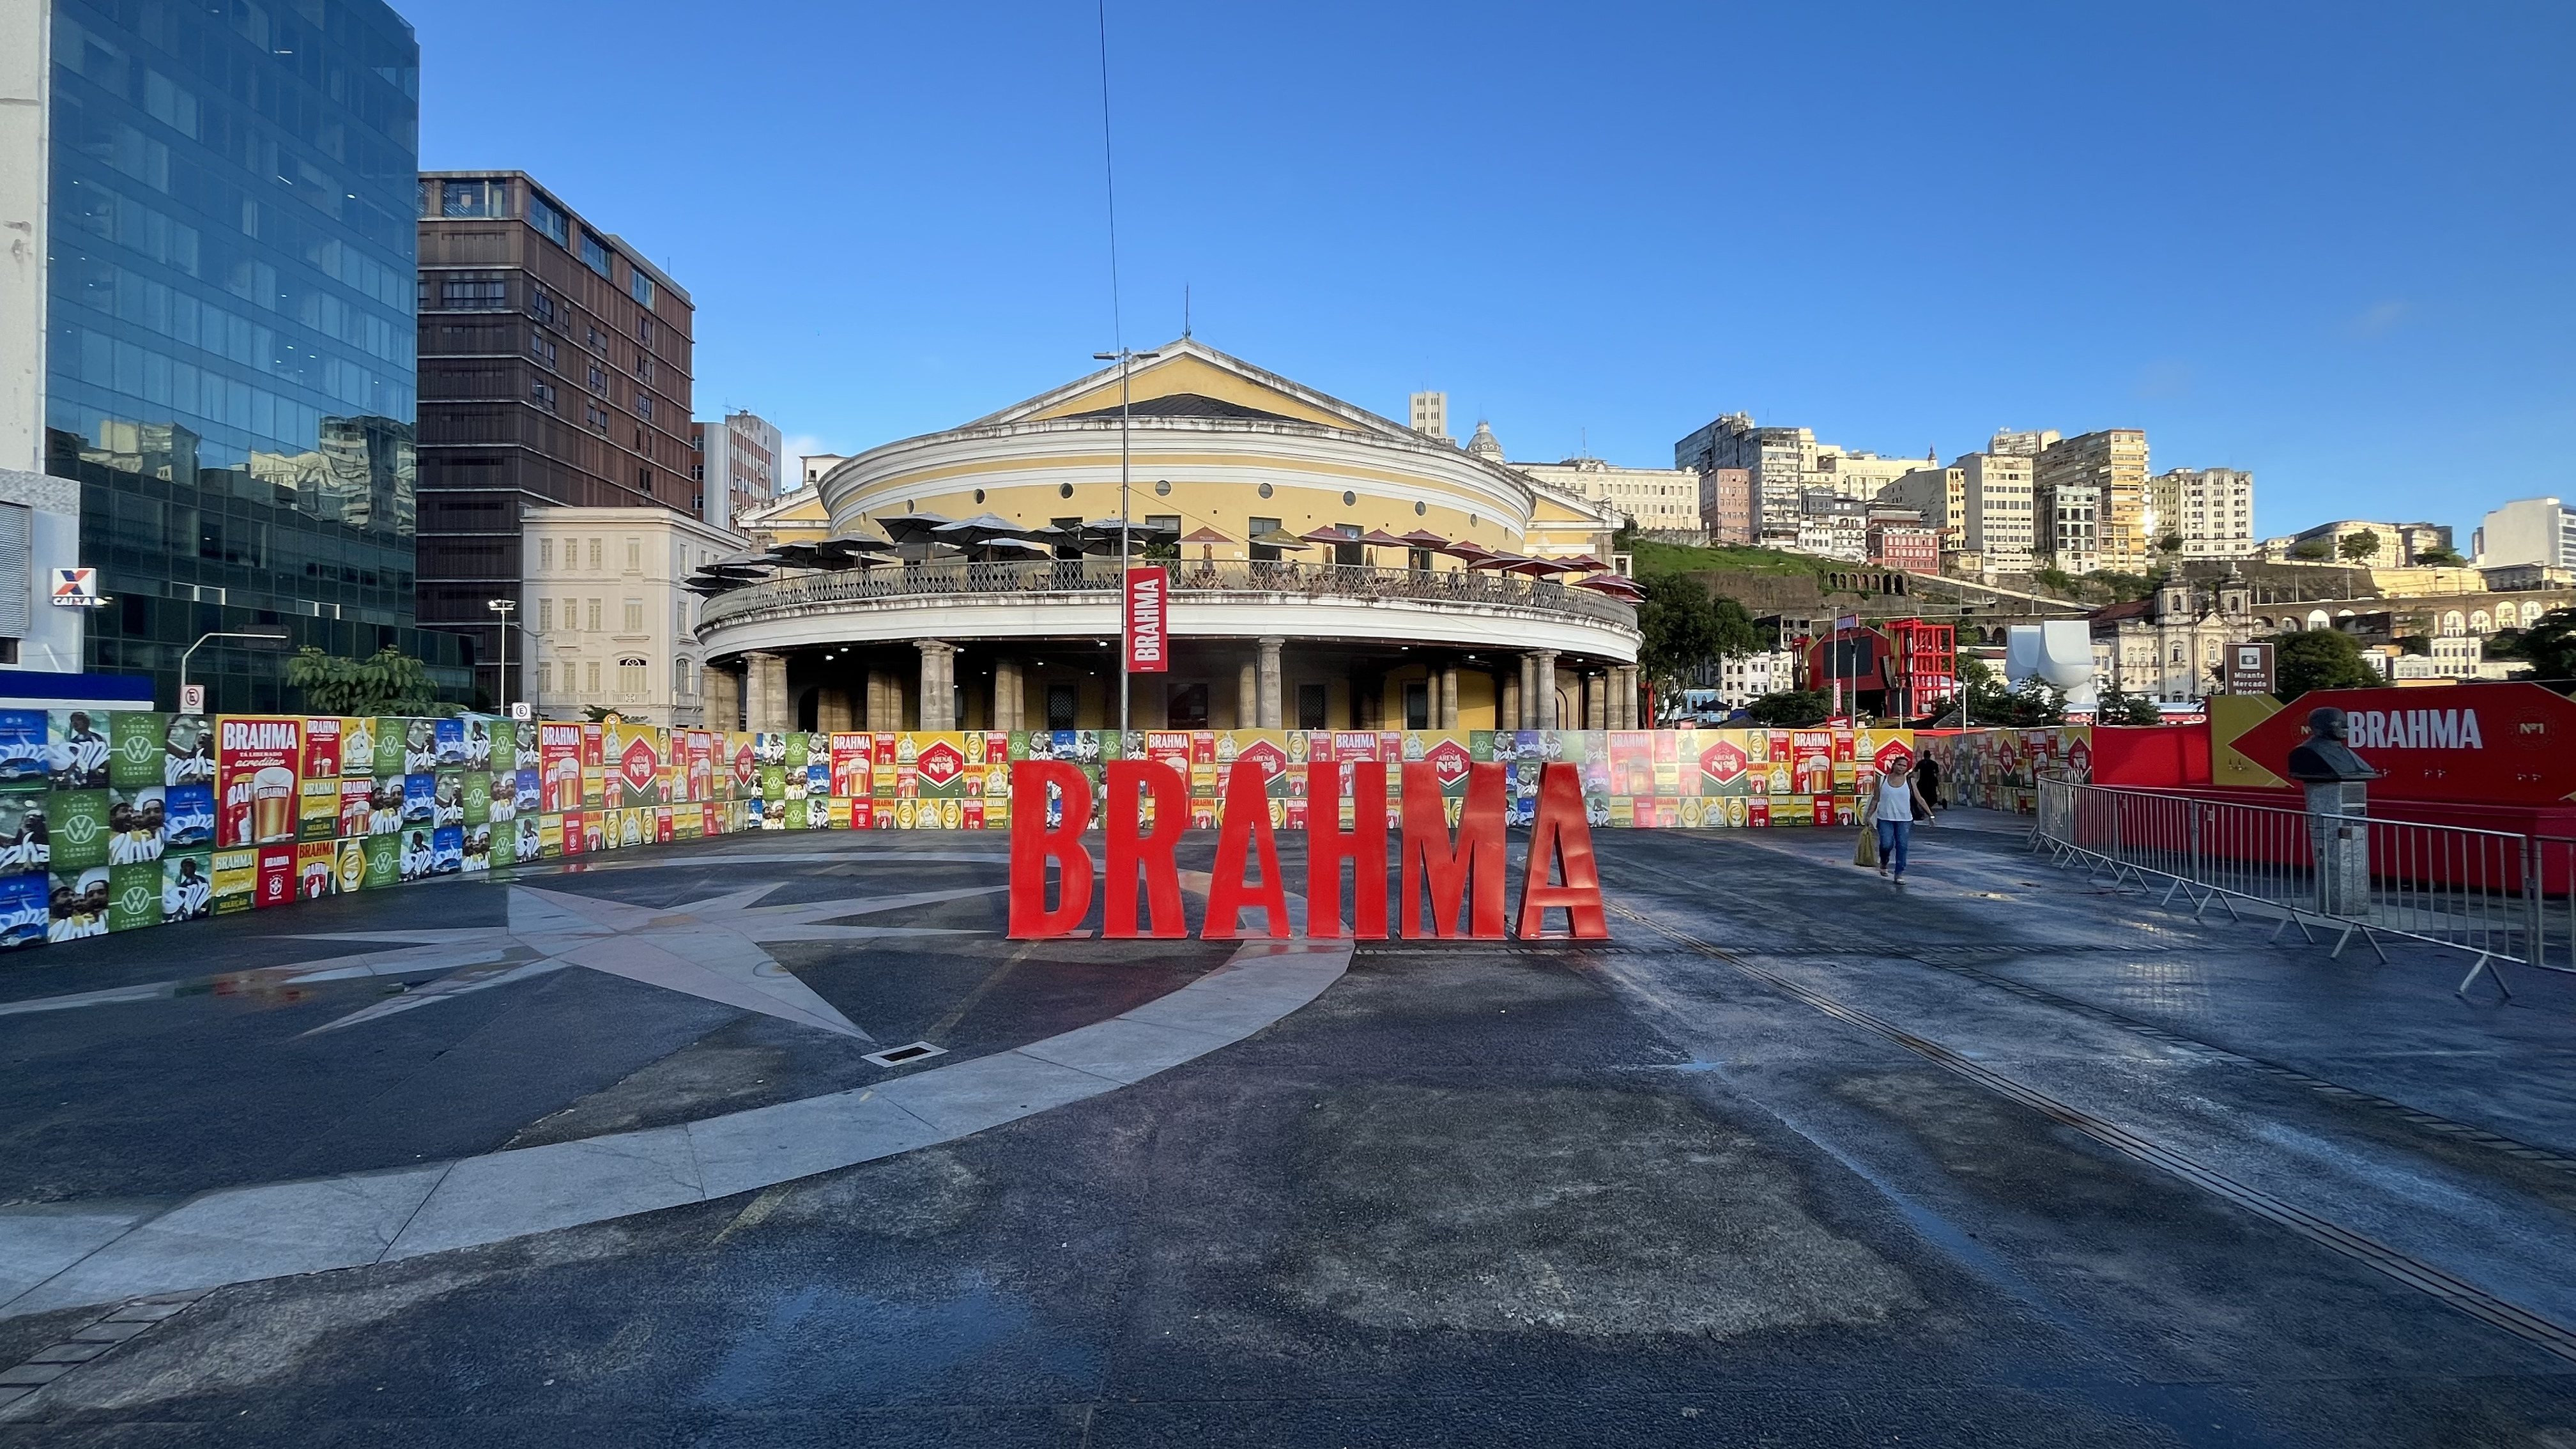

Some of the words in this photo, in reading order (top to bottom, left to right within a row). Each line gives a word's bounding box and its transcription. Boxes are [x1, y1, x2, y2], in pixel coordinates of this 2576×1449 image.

[1134, 578, 1160, 661] BRAHMA
[189, 691, 195, 702] E
[307, 721, 340, 733] BRAHMA
[2347, 709, 2483, 749] BRAHMA
[223, 723, 297, 750] BRAHMA
[542, 726, 580, 746] BRAHMA
[833, 735, 871, 750] BRAHMA
[1149, 734, 1188, 748] BRAHMA
[1336, 734, 1376, 748] BRAHMA
[1794, 733, 1831, 747] BRAHMA
[234, 757, 286, 767] acreditar
[304, 782, 335, 795] BRAHMA
[342, 781, 372, 794] BRAHMA
[299, 841, 335, 859] BRAHMA
[1006, 759, 1613, 940] BRAHMA
[215, 854, 254, 870] BRAHMA
